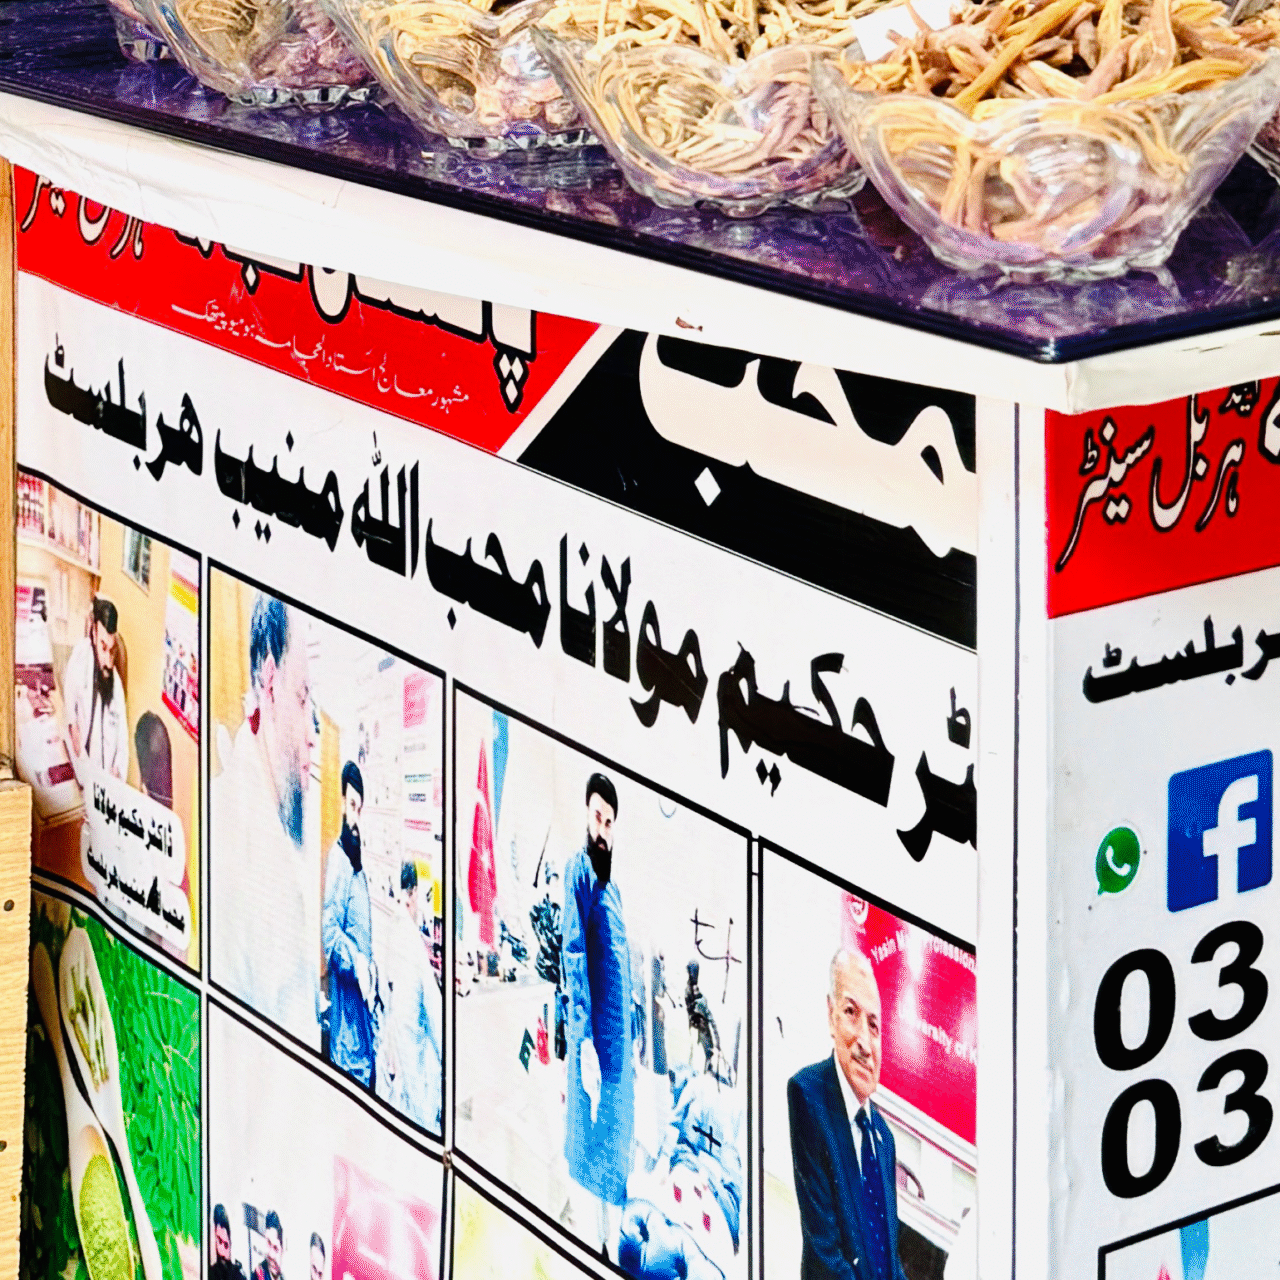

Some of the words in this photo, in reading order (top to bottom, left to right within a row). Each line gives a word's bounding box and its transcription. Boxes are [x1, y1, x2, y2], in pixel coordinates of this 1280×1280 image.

[214, 430, 344, 553] منیب
[425, 517, 551, 649] محب
[560, 532, 708, 728] مولانا
[716, 640, 895, 808] حکیم
